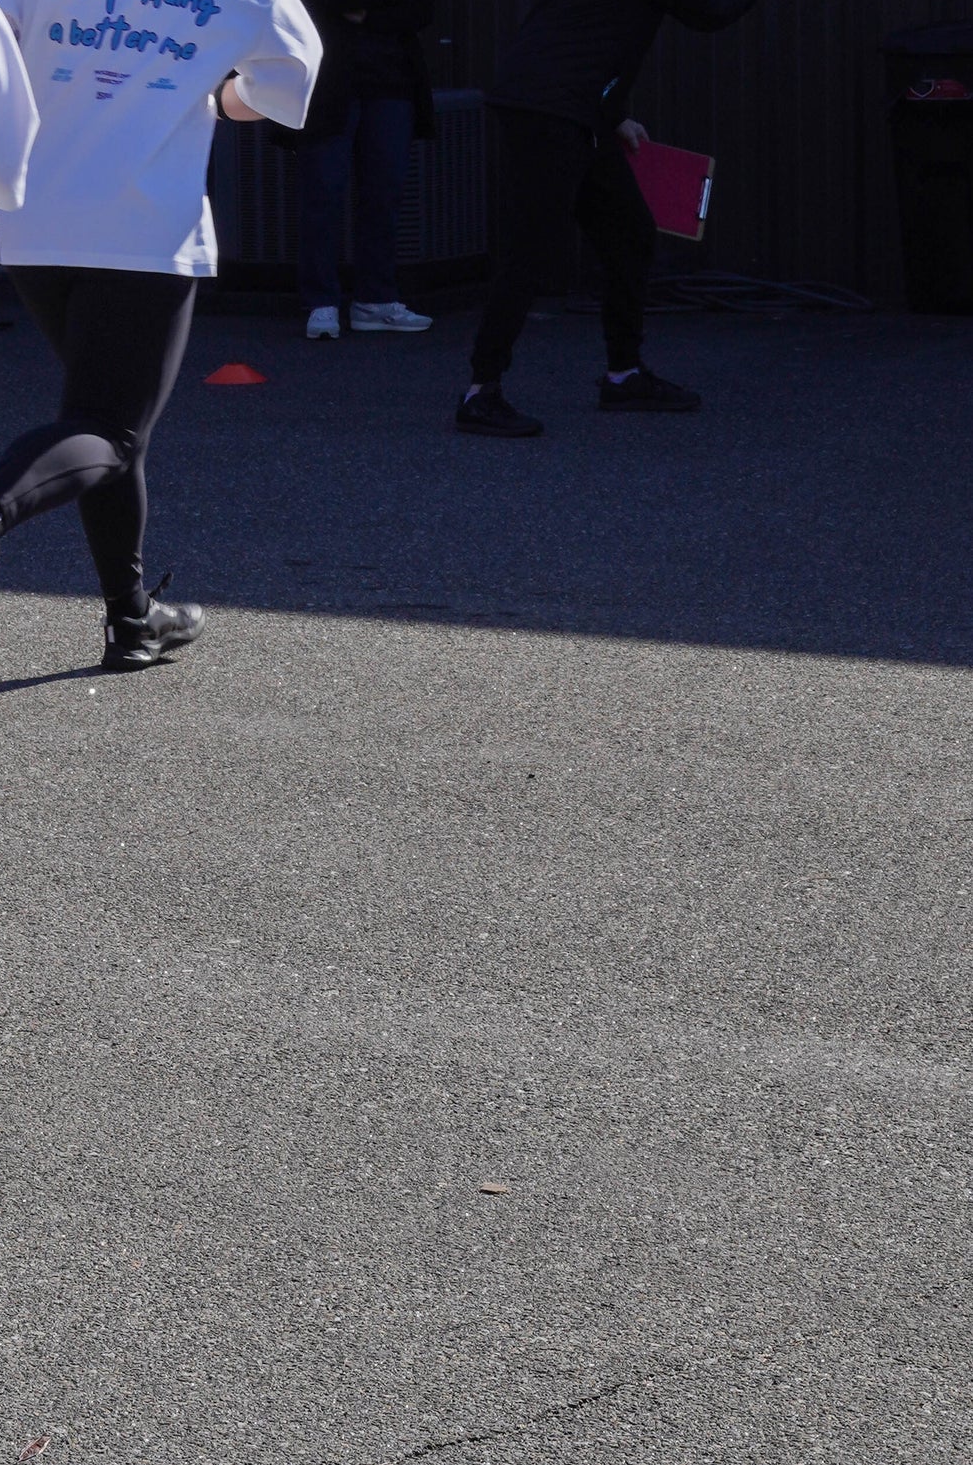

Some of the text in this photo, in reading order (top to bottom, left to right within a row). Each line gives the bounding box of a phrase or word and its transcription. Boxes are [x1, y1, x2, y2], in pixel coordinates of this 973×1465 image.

[48, 14, 198, 61] a better me
